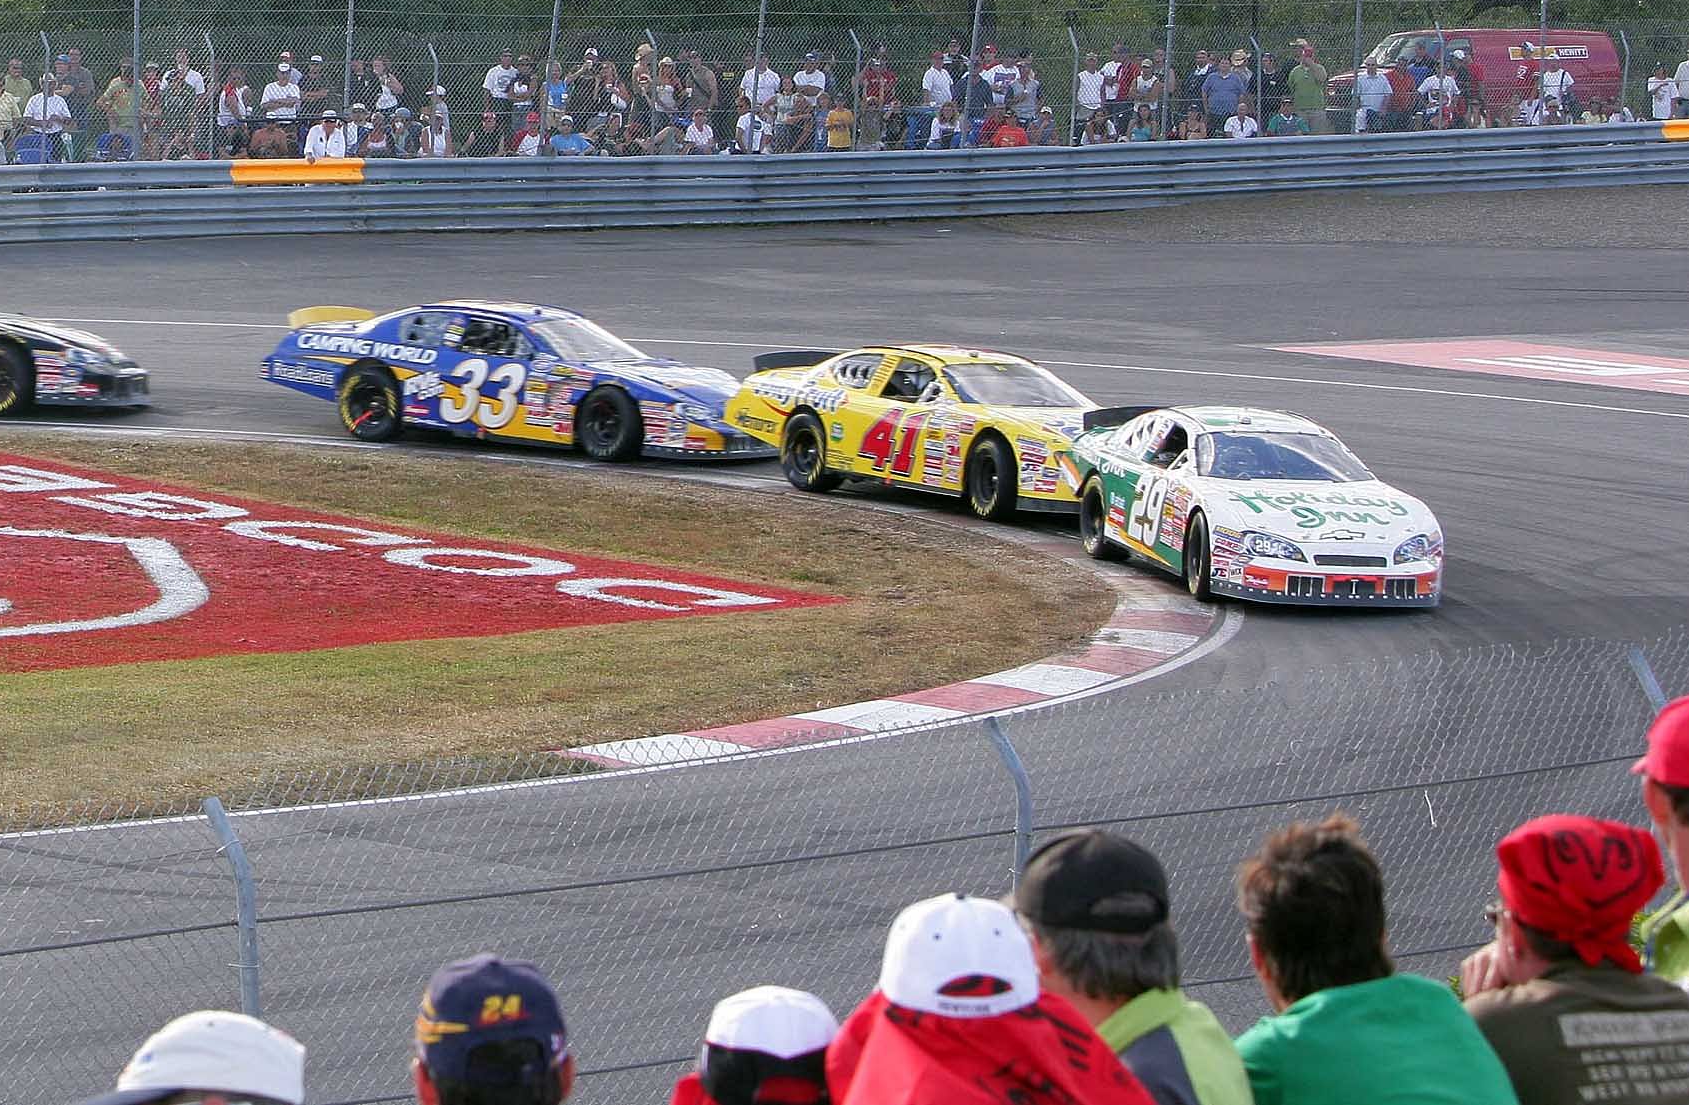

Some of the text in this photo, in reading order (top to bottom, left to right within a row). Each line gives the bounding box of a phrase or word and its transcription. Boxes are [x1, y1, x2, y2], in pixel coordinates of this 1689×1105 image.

[296, 332, 440, 365] CAMPING WORLD
[438, 357, 528, 430] 33
[857, 406, 931, 477] 41
[1128, 471, 1169, 547] 29
[1228, 489, 1409, 516] Holiday
[1290, 505, 1391, 529] Inn
[1255, 539, 1272, 553] 29
[480, 994, 522, 1023] 24
